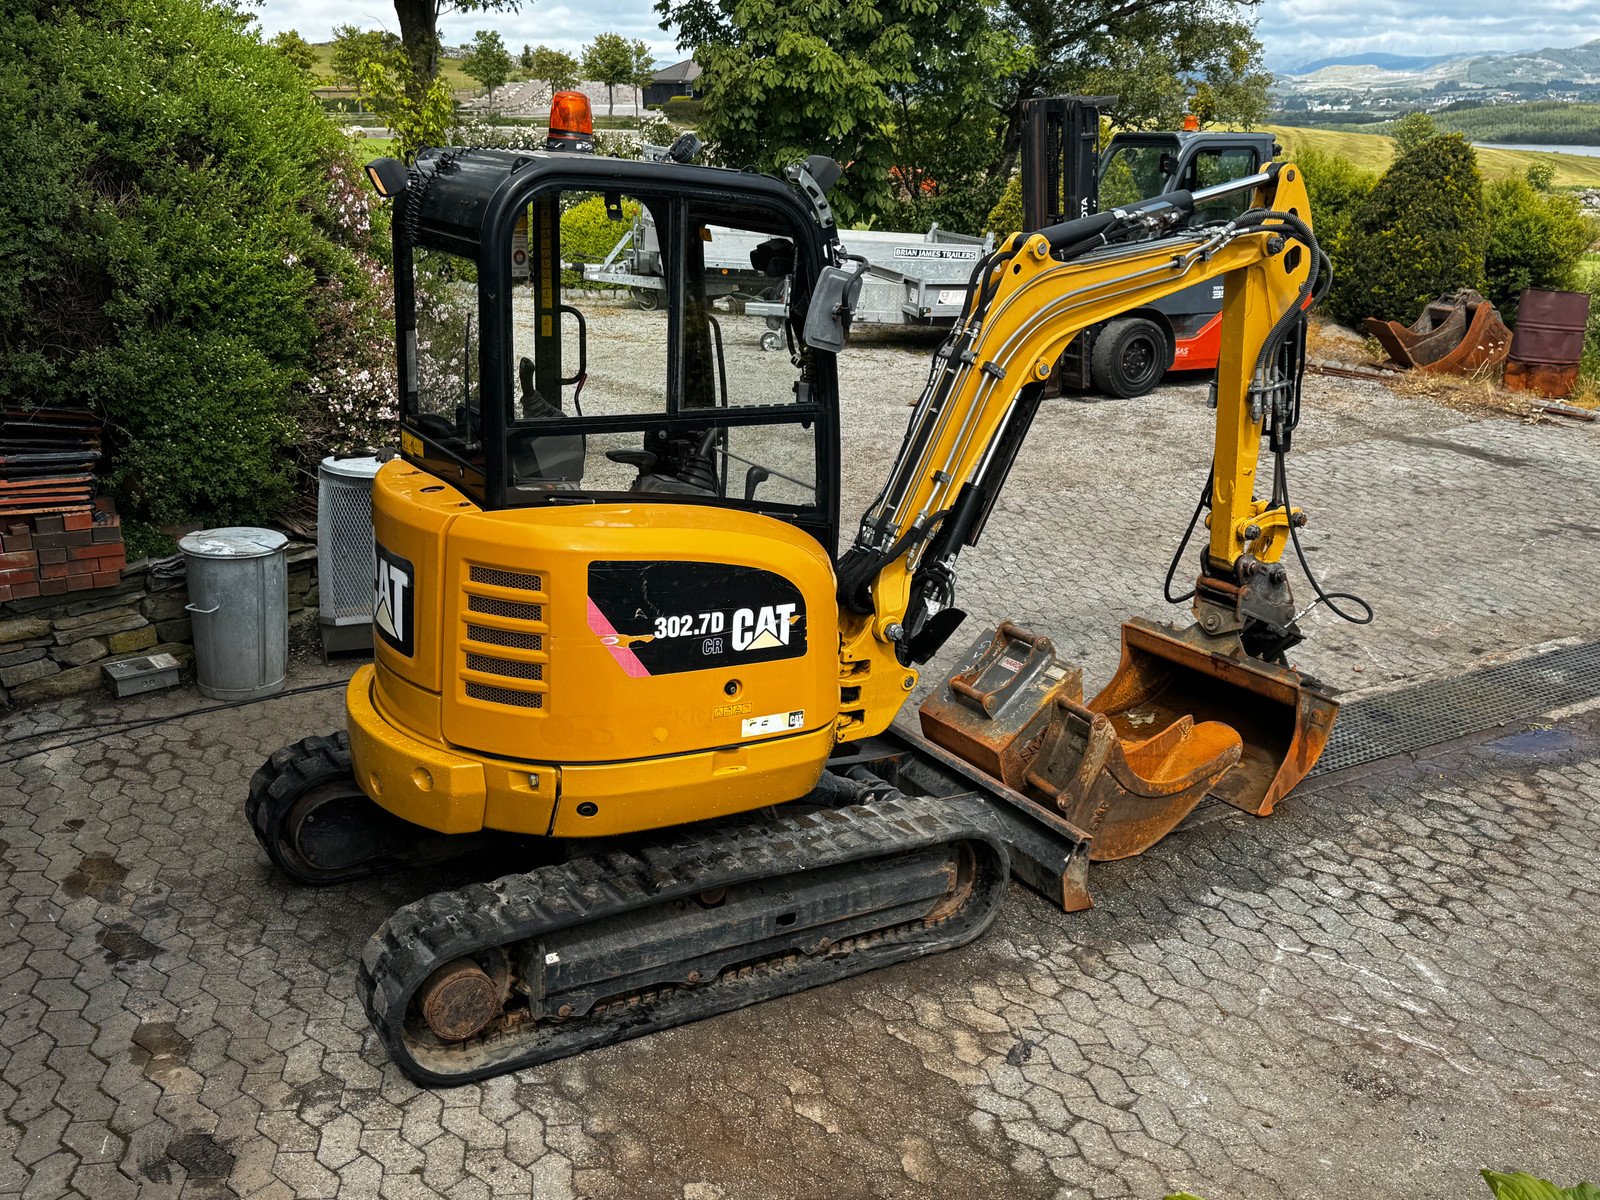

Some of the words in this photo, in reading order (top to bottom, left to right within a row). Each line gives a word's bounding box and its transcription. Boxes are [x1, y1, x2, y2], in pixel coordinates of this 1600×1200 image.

[895, 248, 918, 256] BRIAN
[918, 249, 941, 258] JAMES
[942, 251, 975, 259] TRAILERS
[654, 611, 725, 639] 302.7D
[731, 602, 796, 652] CAT
[702, 637, 723, 656] CR
[788, 713, 804, 725] CAT
